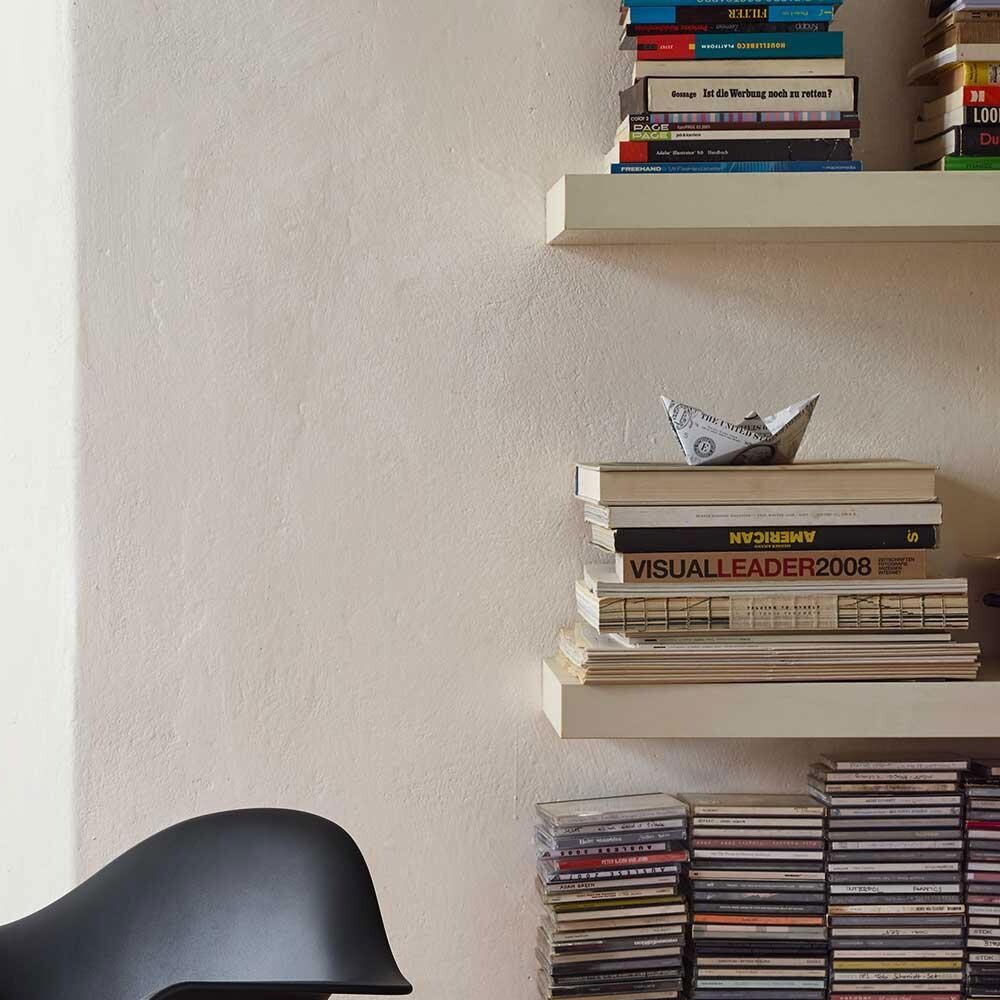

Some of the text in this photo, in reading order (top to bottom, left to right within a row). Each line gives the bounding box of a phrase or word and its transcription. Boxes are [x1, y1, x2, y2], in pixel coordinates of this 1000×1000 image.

[728, 8, 768, 20] FILTER
[703, 88, 714, 98] Ist
[716, 88, 729, 98] die
[730, 88, 767, 100] Werbung
[768, 88, 788, 98] noch
[789, 90, 800, 98] zu
[974, 107, 1000, 123] LOO
[633, 123, 670, 131] PAGE
[632, 131, 669, 139] PAGE
[701, 412, 719, 425] THE
[729, 530, 816, 545] AMERICAN
